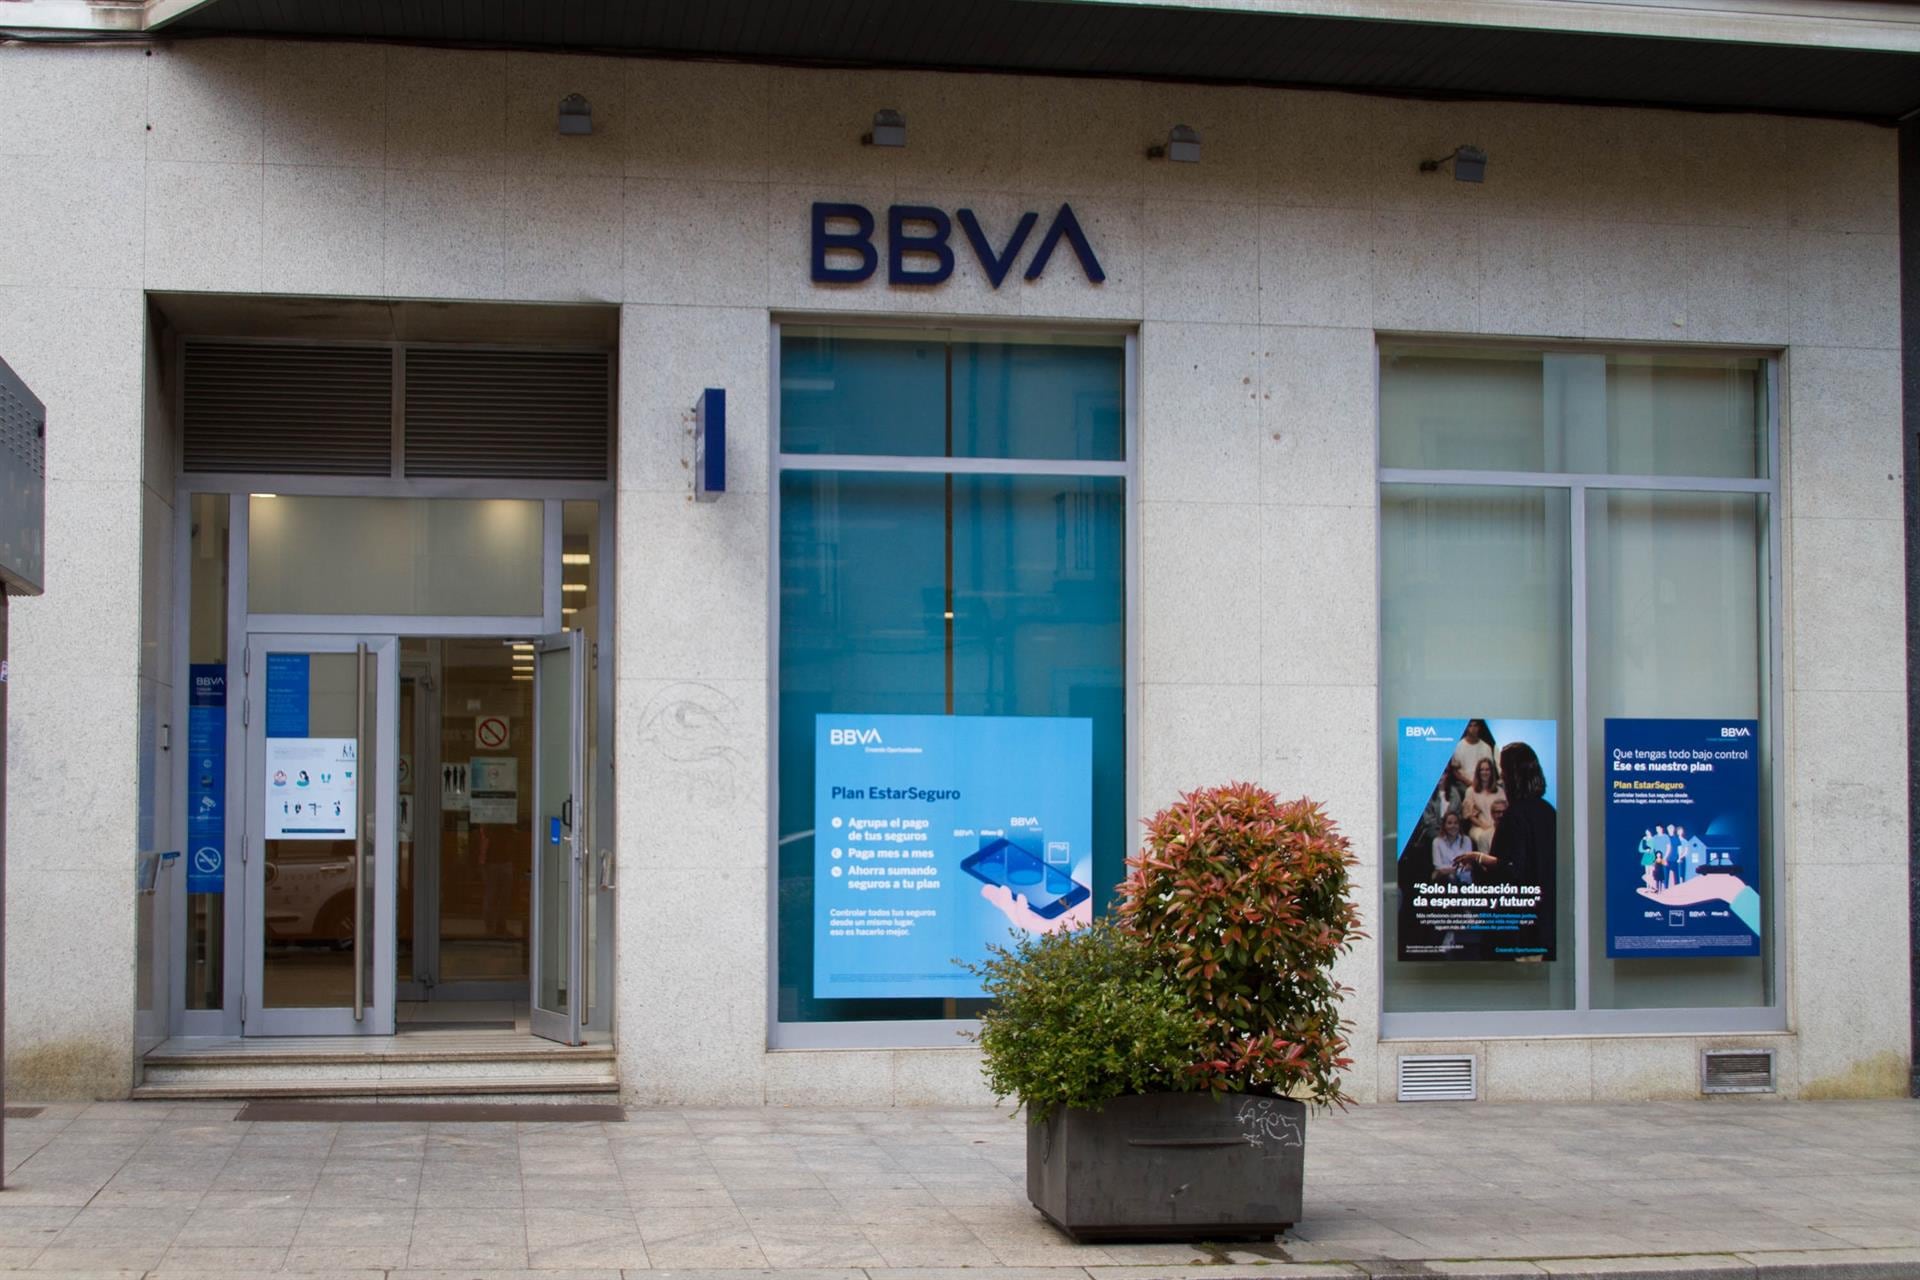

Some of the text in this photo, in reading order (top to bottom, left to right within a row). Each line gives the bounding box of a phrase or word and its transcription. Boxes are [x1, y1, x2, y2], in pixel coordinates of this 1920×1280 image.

[811, 202, 1106, 290] BBVA
[196, 677, 224, 686] BBVA
[830, 728, 882, 745] BBVA
[1406, 726, 1437, 737] BBVA
[1721, 728, 1750, 737] BBVA
[1613, 748, 1748, 761] Que tengas todo bajo control
[1613, 761, 1713, 773] Ese es nuestro plan
[1613, 781, 1684, 791] Plan EstarSeguro
[832, 786, 960, 802] Plan EstarSeguro
[848, 817, 929, 830] Agrupa el pago
[1010, 817, 1038, 826] BBVA
[848, 831, 927, 843] de tus seguros
[848, 848, 934, 860] Paga mes a mes
[848, 865, 937, 875] Ahorra sumando
[848, 879, 940, 890] seguros a tu plan
[1448, 883, 1458, 894] la
[1460, 883, 1518, 894] educación
[1520, 885, 1541, 895] nos
[1413, 896, 1427, 907] da
[1430, 898, 1487, 909] esperanza
[1490, 898, 1497, 909] y
[830, 909, 936, 918] Controlar todos tus seguros
